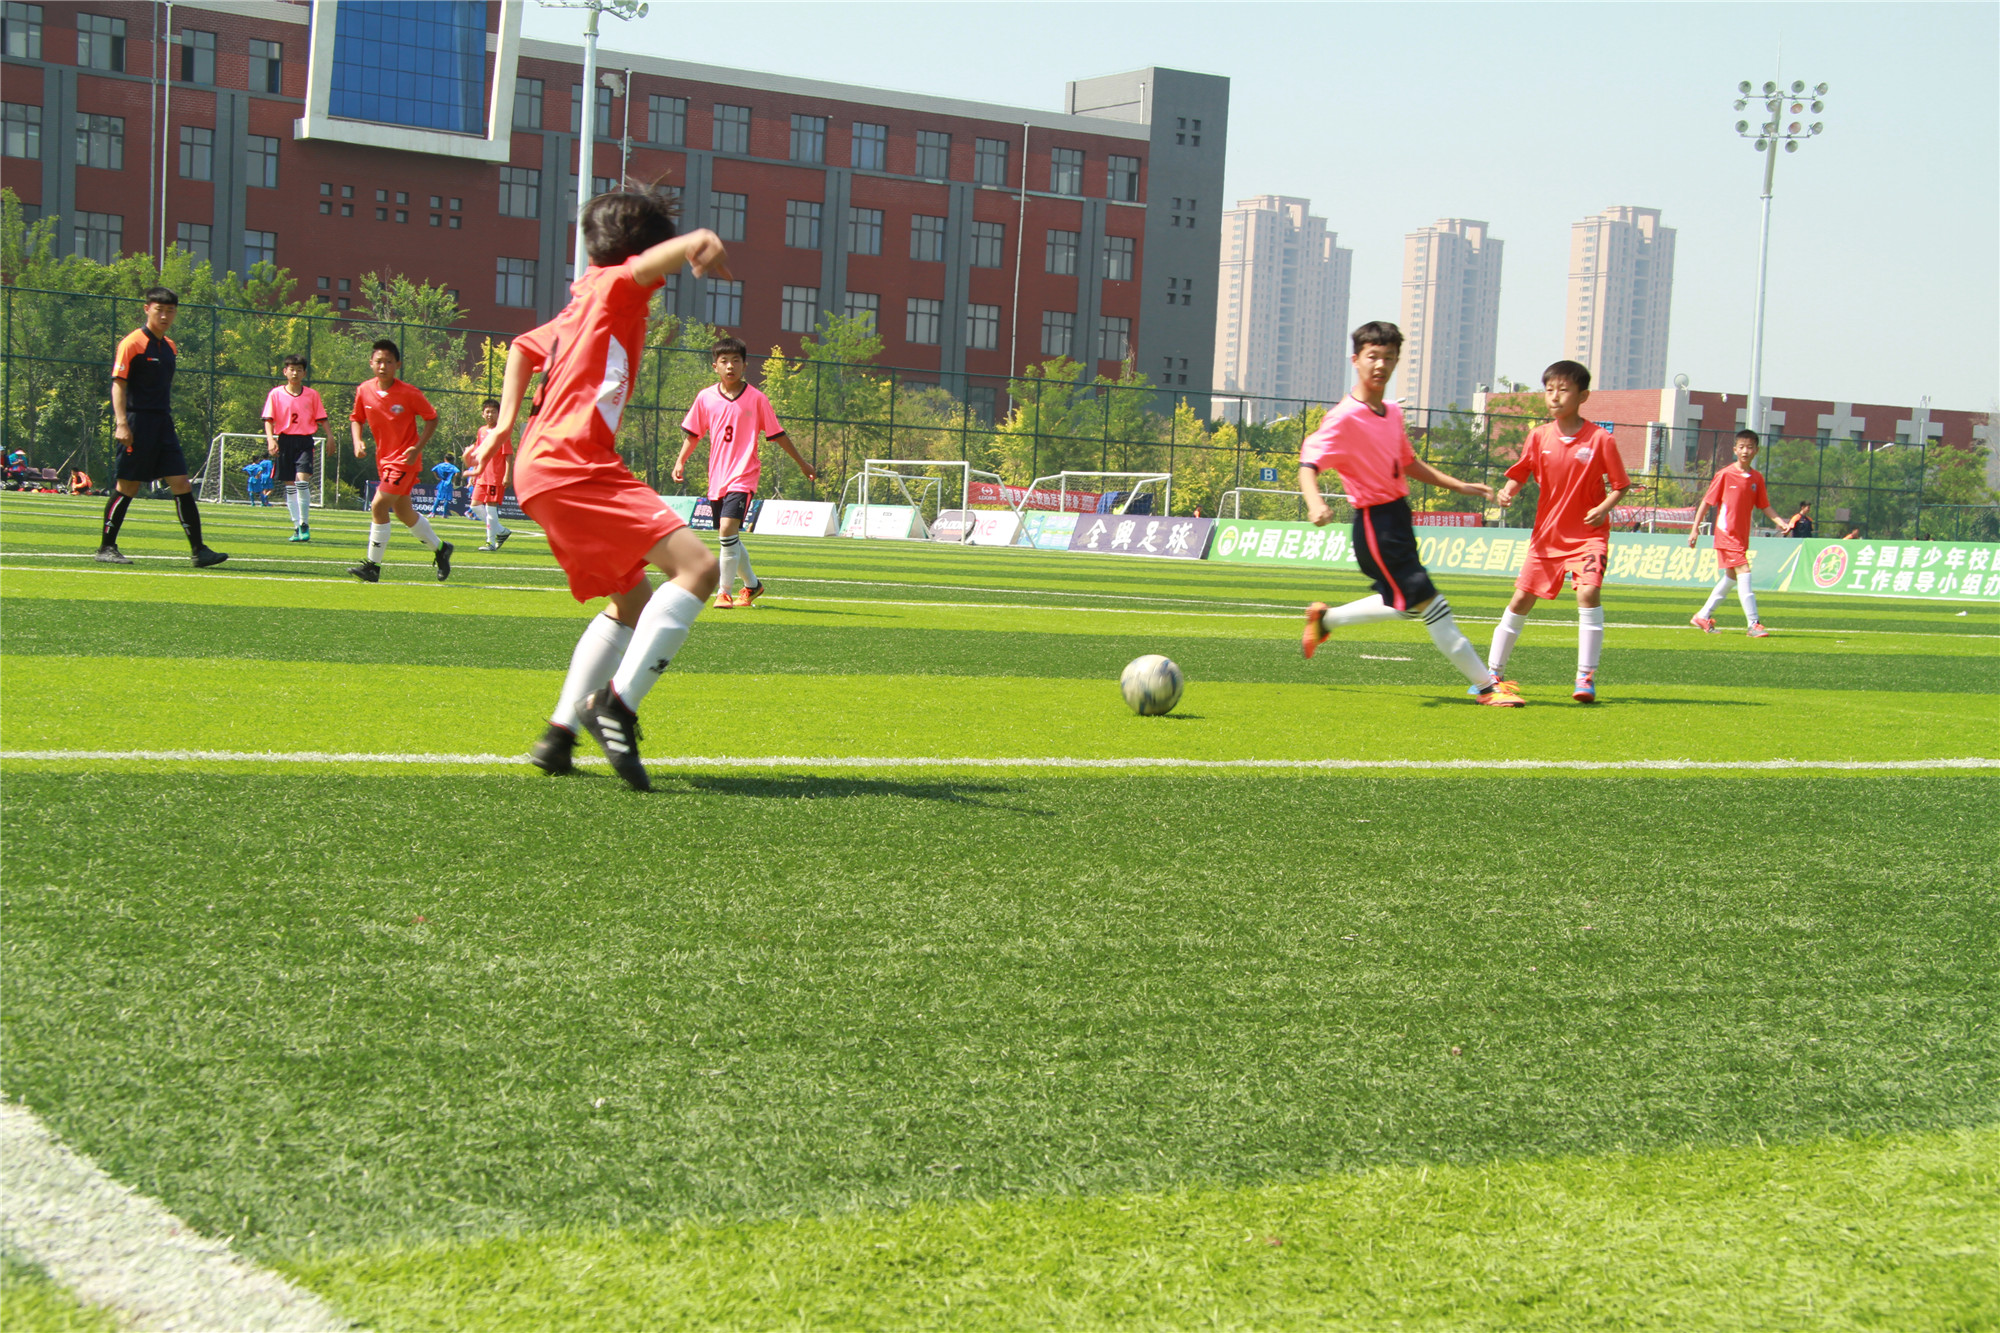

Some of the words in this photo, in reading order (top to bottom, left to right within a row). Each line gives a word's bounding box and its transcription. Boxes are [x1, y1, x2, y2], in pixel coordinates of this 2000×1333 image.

[291, 413, 299, 424] 2
[724, 425, 733, 443] 3
[382, 467, 406, 486] 17
[1264, 469, 1274, 481] B
[775, 509, 814, 527] vanke
